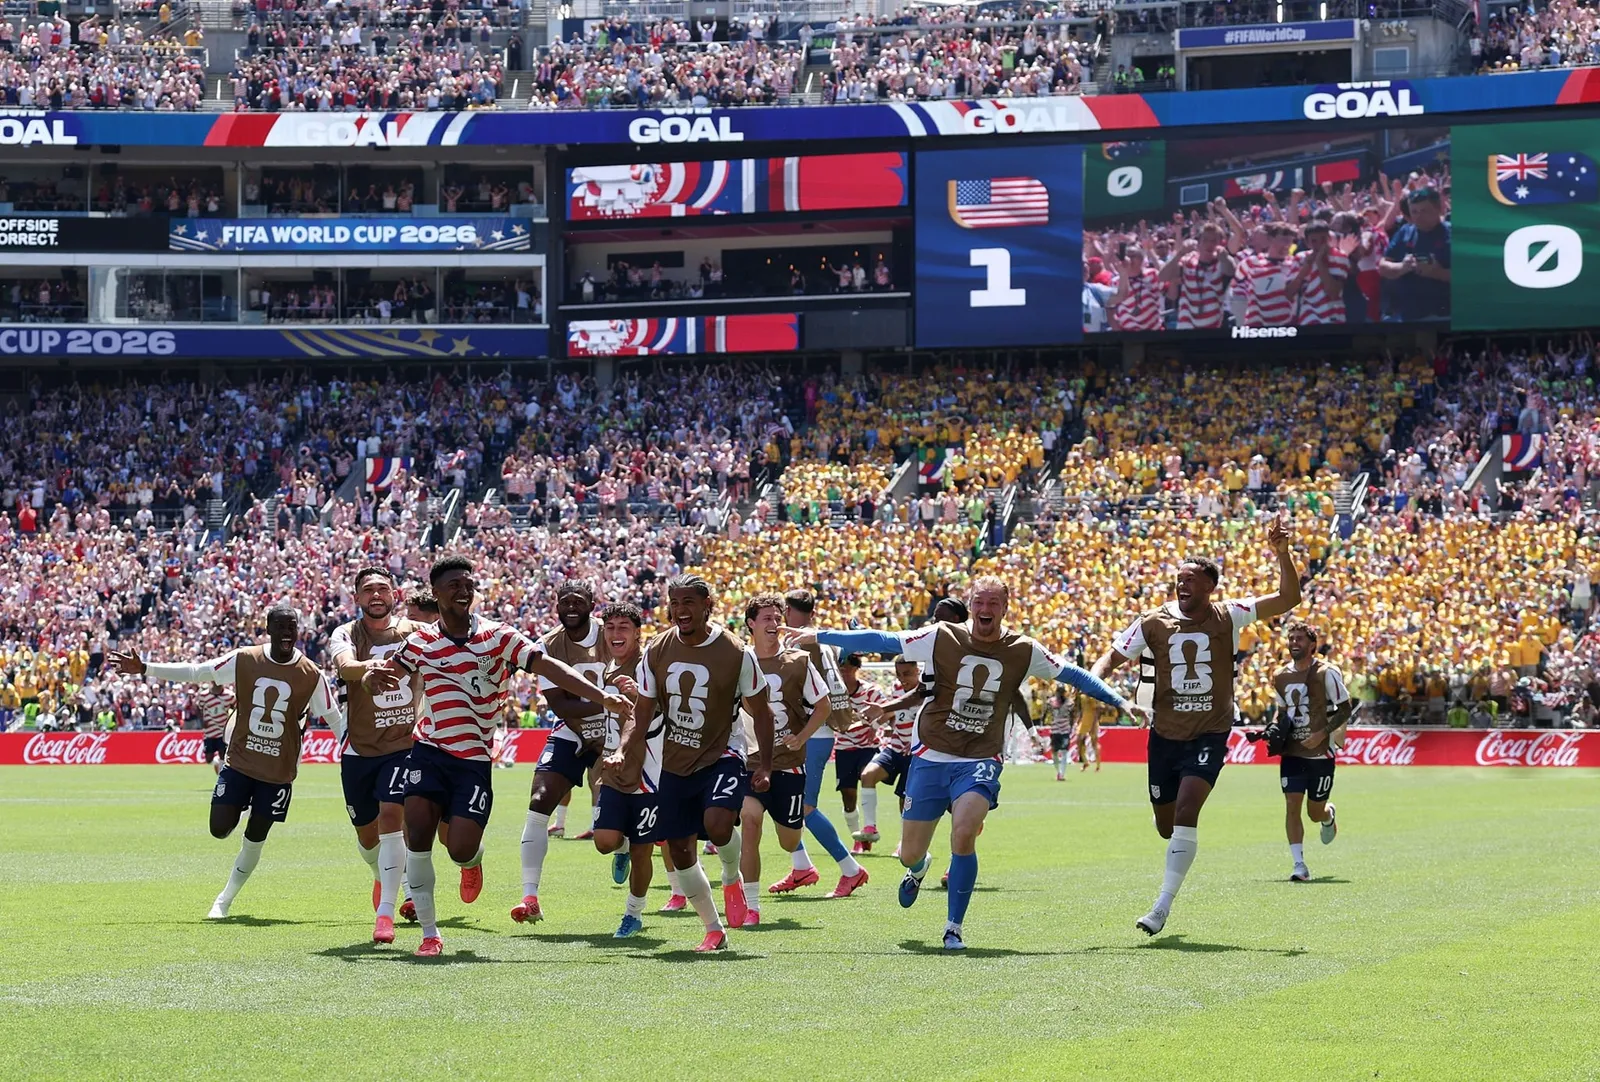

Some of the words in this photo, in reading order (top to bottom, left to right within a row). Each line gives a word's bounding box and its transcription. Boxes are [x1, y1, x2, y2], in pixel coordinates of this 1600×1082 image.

[1225, 28, 1306, 43] #FIFAWorldCup
[1303, 89, 1424, 120] GOAL
[963, 106, 1079, 134] GOAL
[297, 121, 411, 146] GOAL
[629, 116, 744, 143] GOAL
[0, 219, 59, 232] OFFSIDE
[222, 226, 269, 243] FIFA
[271, 226, 350, 243] WORLD
[353, 226, 397, 243] CUP
[400, 225, 477, 243] 2026
[970, 247, 1026, 308] 1
[1231, 326, 1298, 338] Hisense
[0, 330, 61, 354] CUP
[66, 330, 176, 355] 2026
[1183, 682, 1202, 690] FIFA
[385, 693, 404, 702] FIFA
[374, 708, 401, 718] WORLD
[962, 705, 982, 715] FIFA
[1173, 702, 1213, 712] 2026
[375, 714, 415, 729] 2026
[677, 714, 694, 724] FIFA
[257, 724, 274, 733] FIFA
[688, 731, 702, 739] CUP
[23, 732, 110, 764] Coca-Cola
[245, 740, 281, 757] 2026
[247, 735, 269, 745] WORLD
[667, 731, 701, 749] 2026
[1475, 730, 1586, 766] Coca-Cola
[972, 762, 997, 780] 25
[712, 773, 738, 796] 12
[1316, 775, 1331, 792] 10
[271, 788, 291, 809] 21
[468, 785, 488, 811] 16
[788, 793, 803, 817] 11
[636, 805, 659, 830] 26
